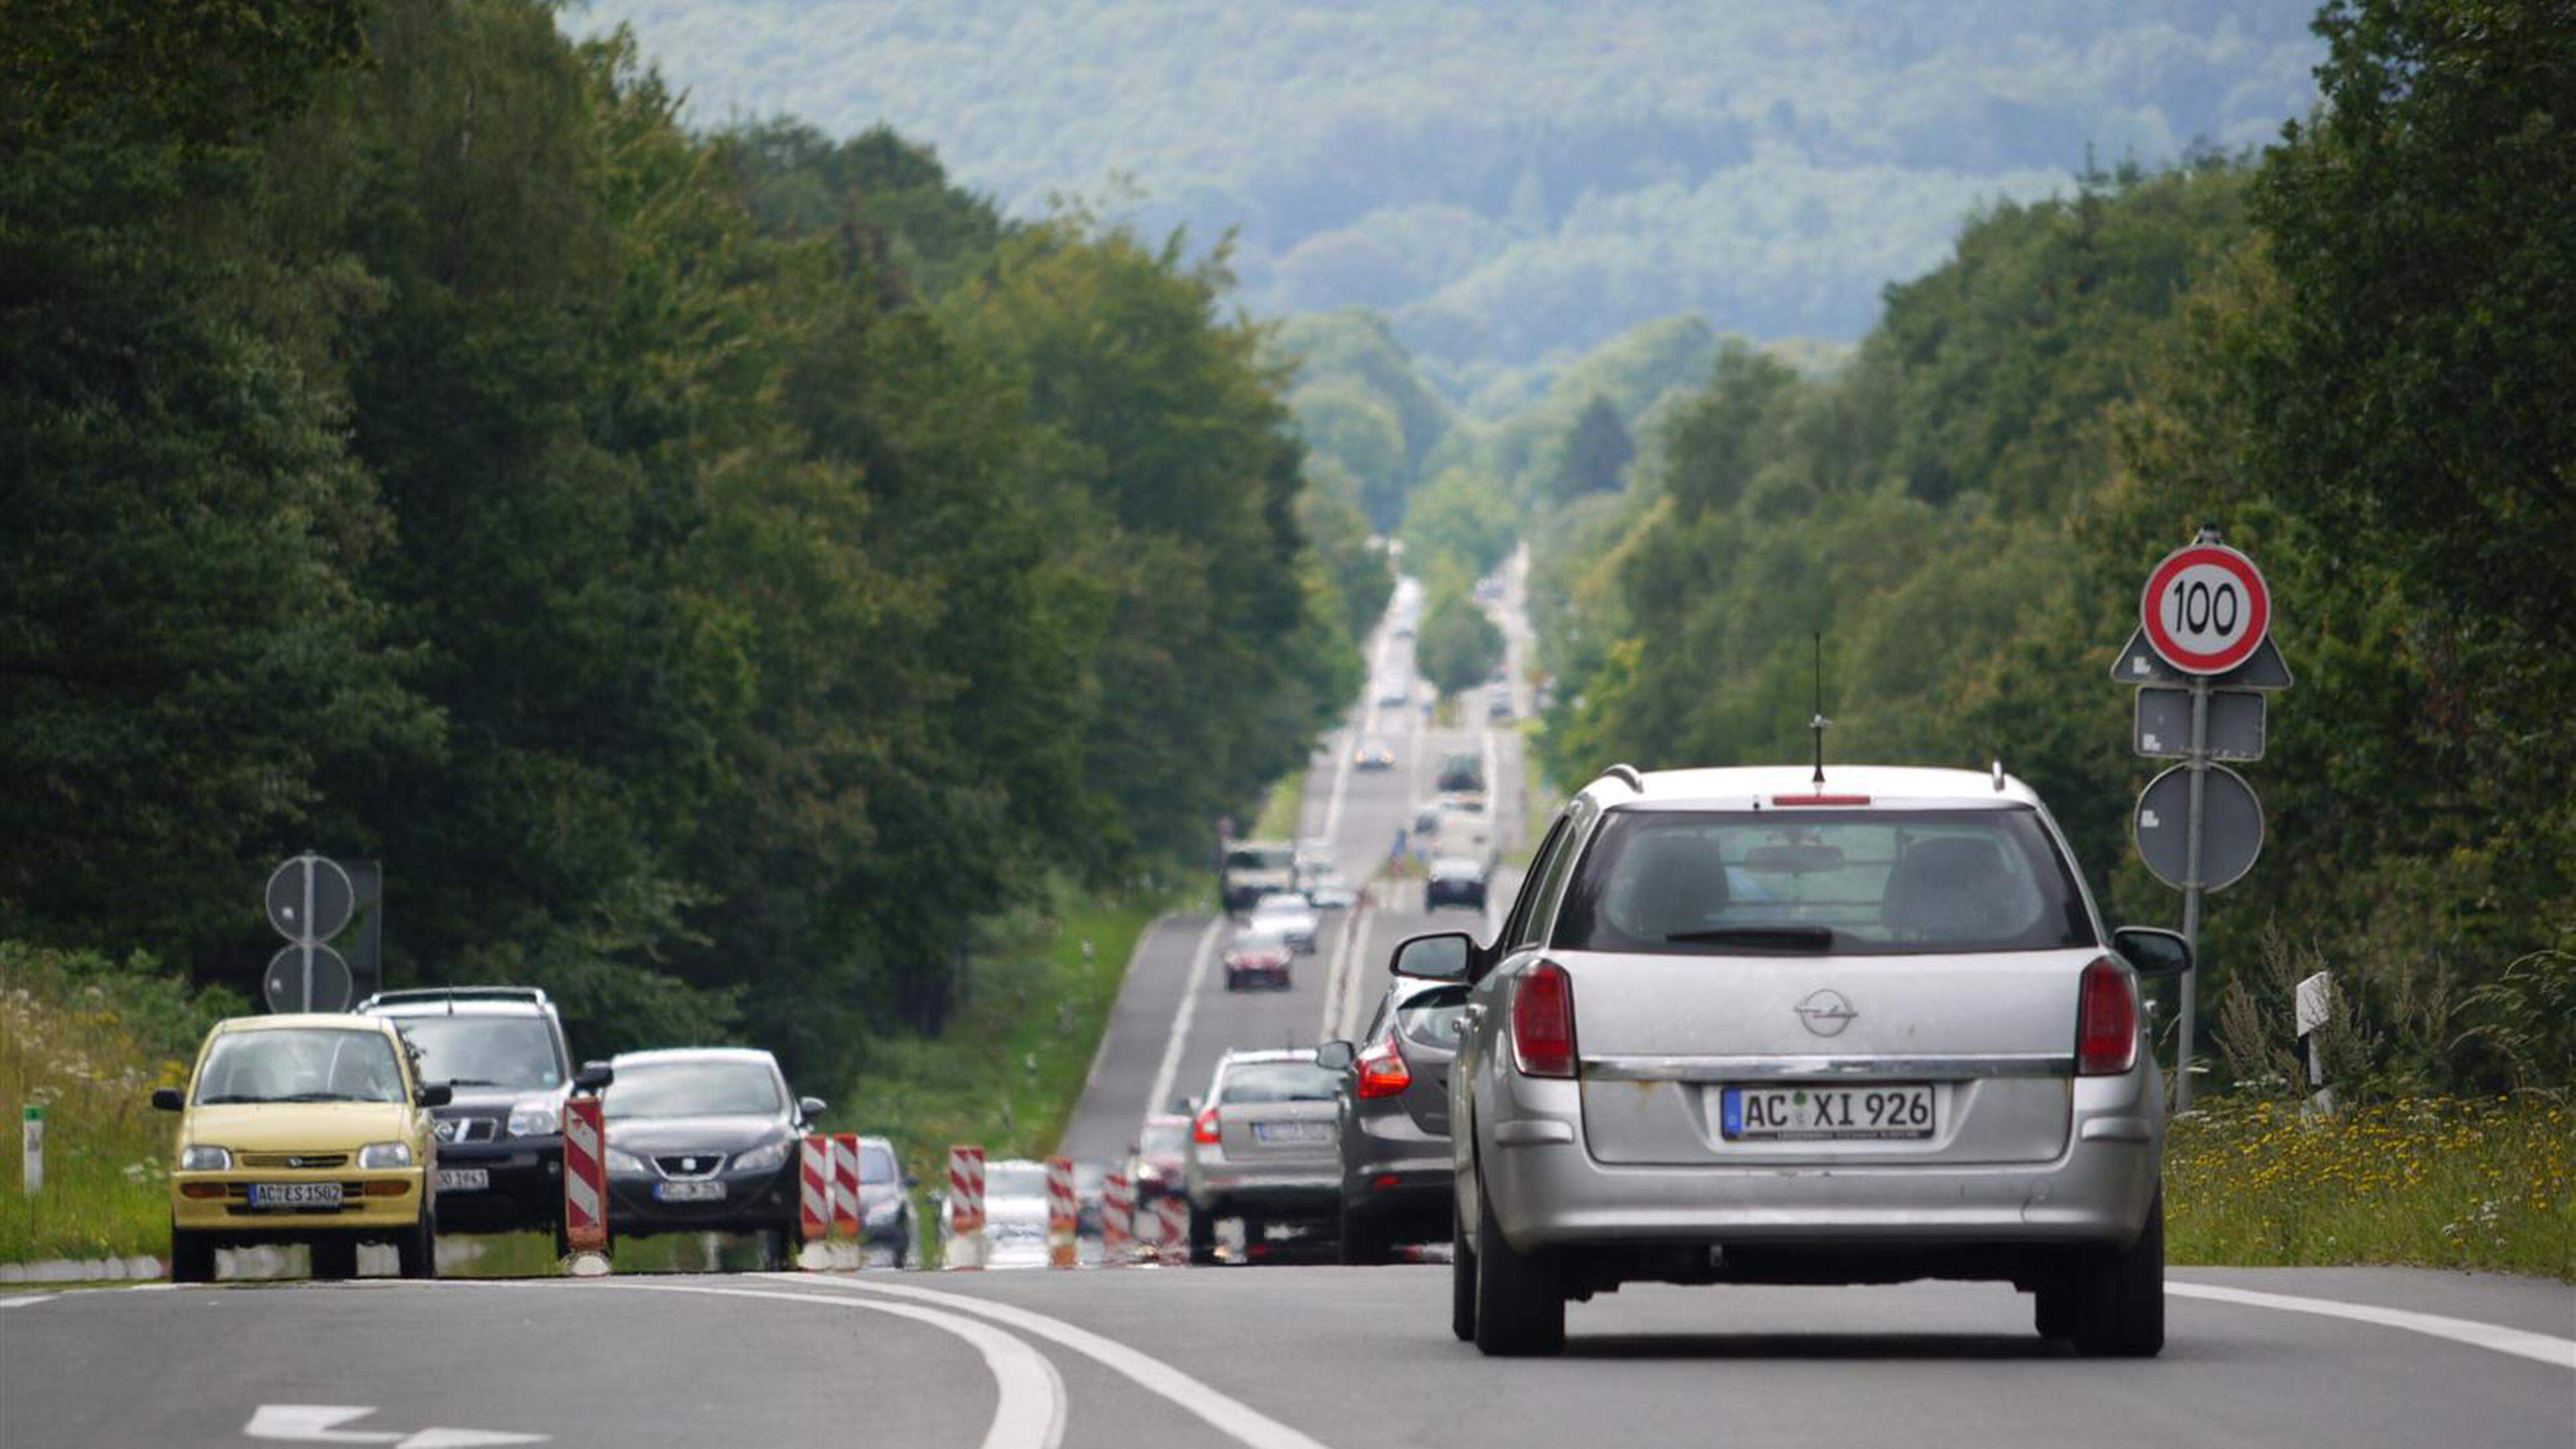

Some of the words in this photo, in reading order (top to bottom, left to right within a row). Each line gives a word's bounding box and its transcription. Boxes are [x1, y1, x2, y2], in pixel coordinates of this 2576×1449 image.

[2175, 580, 2237, 637] 100
[1745, 1095, 1788, 1126] AC
[1813, 1093, 1854, 1126] XI
[1866, 1093, 1929, 1126] 926
[259, 1186, 276, 1201] AC
[284, 1185, 302, 1201] ES
